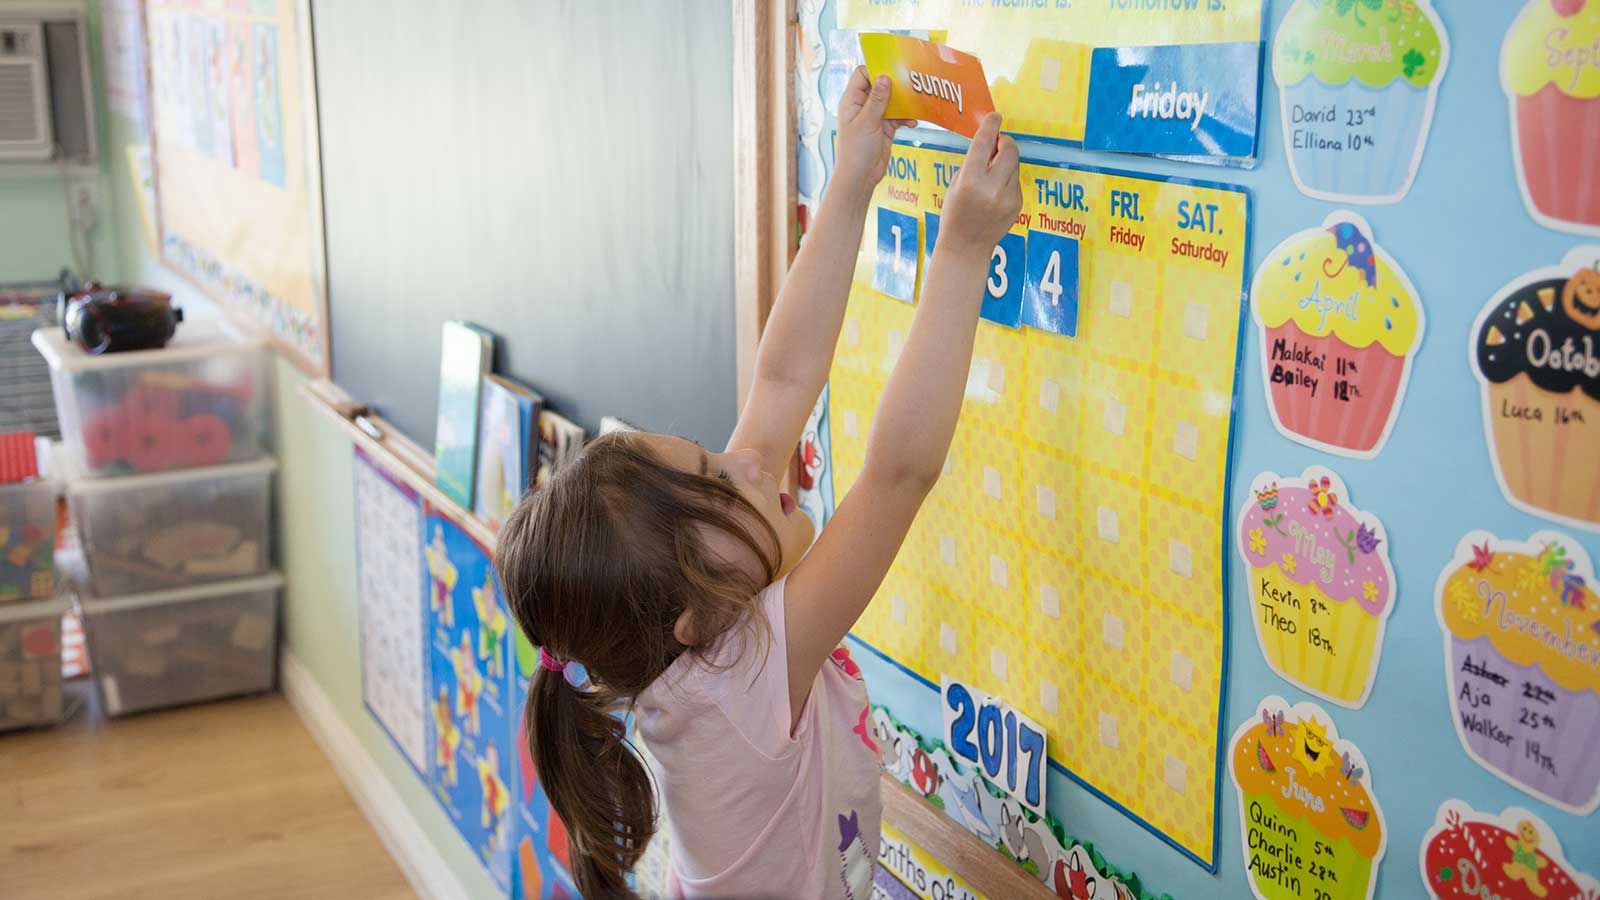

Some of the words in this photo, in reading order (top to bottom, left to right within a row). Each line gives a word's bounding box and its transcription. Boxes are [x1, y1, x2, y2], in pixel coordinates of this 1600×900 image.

[1317, 26, 1393, 64] March
[909, 70, 963, 113] sunny
[1129, 81, 1208, 131] Friday
[1292, 105, 1336, 124] David
[1346, 106, 1376, 126] 23rd
[1293, 130, 1342, 150] Elliana
[1347, 133, 1374, 150] 10th
[888, 156, 920, 183] MON.
[888, 184, 919, 206] Monday
[1035, 178, 1089, 212] THUR.
[1111, 190, 1144, 222] FRI.
[1039, 213, 1086, 240] Thursday
[1177, 200, 1223, 235] SAT.
[891, 225, 902, 273] 1
[1110, 226, 1145, 252] Friday
[1171, 237, 1229, 268] Saturday
[987, 245, 1008, 298] 3
[1040, 250, 1063, 306] 4
[1299, 279, 1361, 332] April
[1272, 338, 1326, 371] Malakai
[1270, 363, 1318, 398] Bailey
[1502, 399, 1543, 422] Luca
[1288, 519, 1336, 584] May
[1261, 577, 1301, 610] Kevin
[1260, 603, 1297, 634] Theo
[1460, 681, 1491, 708] Aja
[947, 683, 1044, 807] 2017
[1461, 711, 1514, 747] Walker
[1281, 766, 1325, 813] June
[1250, 801, 1297, 841] Quinn
[880, 837, 926, 891] onths
[1247, 828, 1302, 869] Charlie
[1248, 854, 1301, 896] Austin
